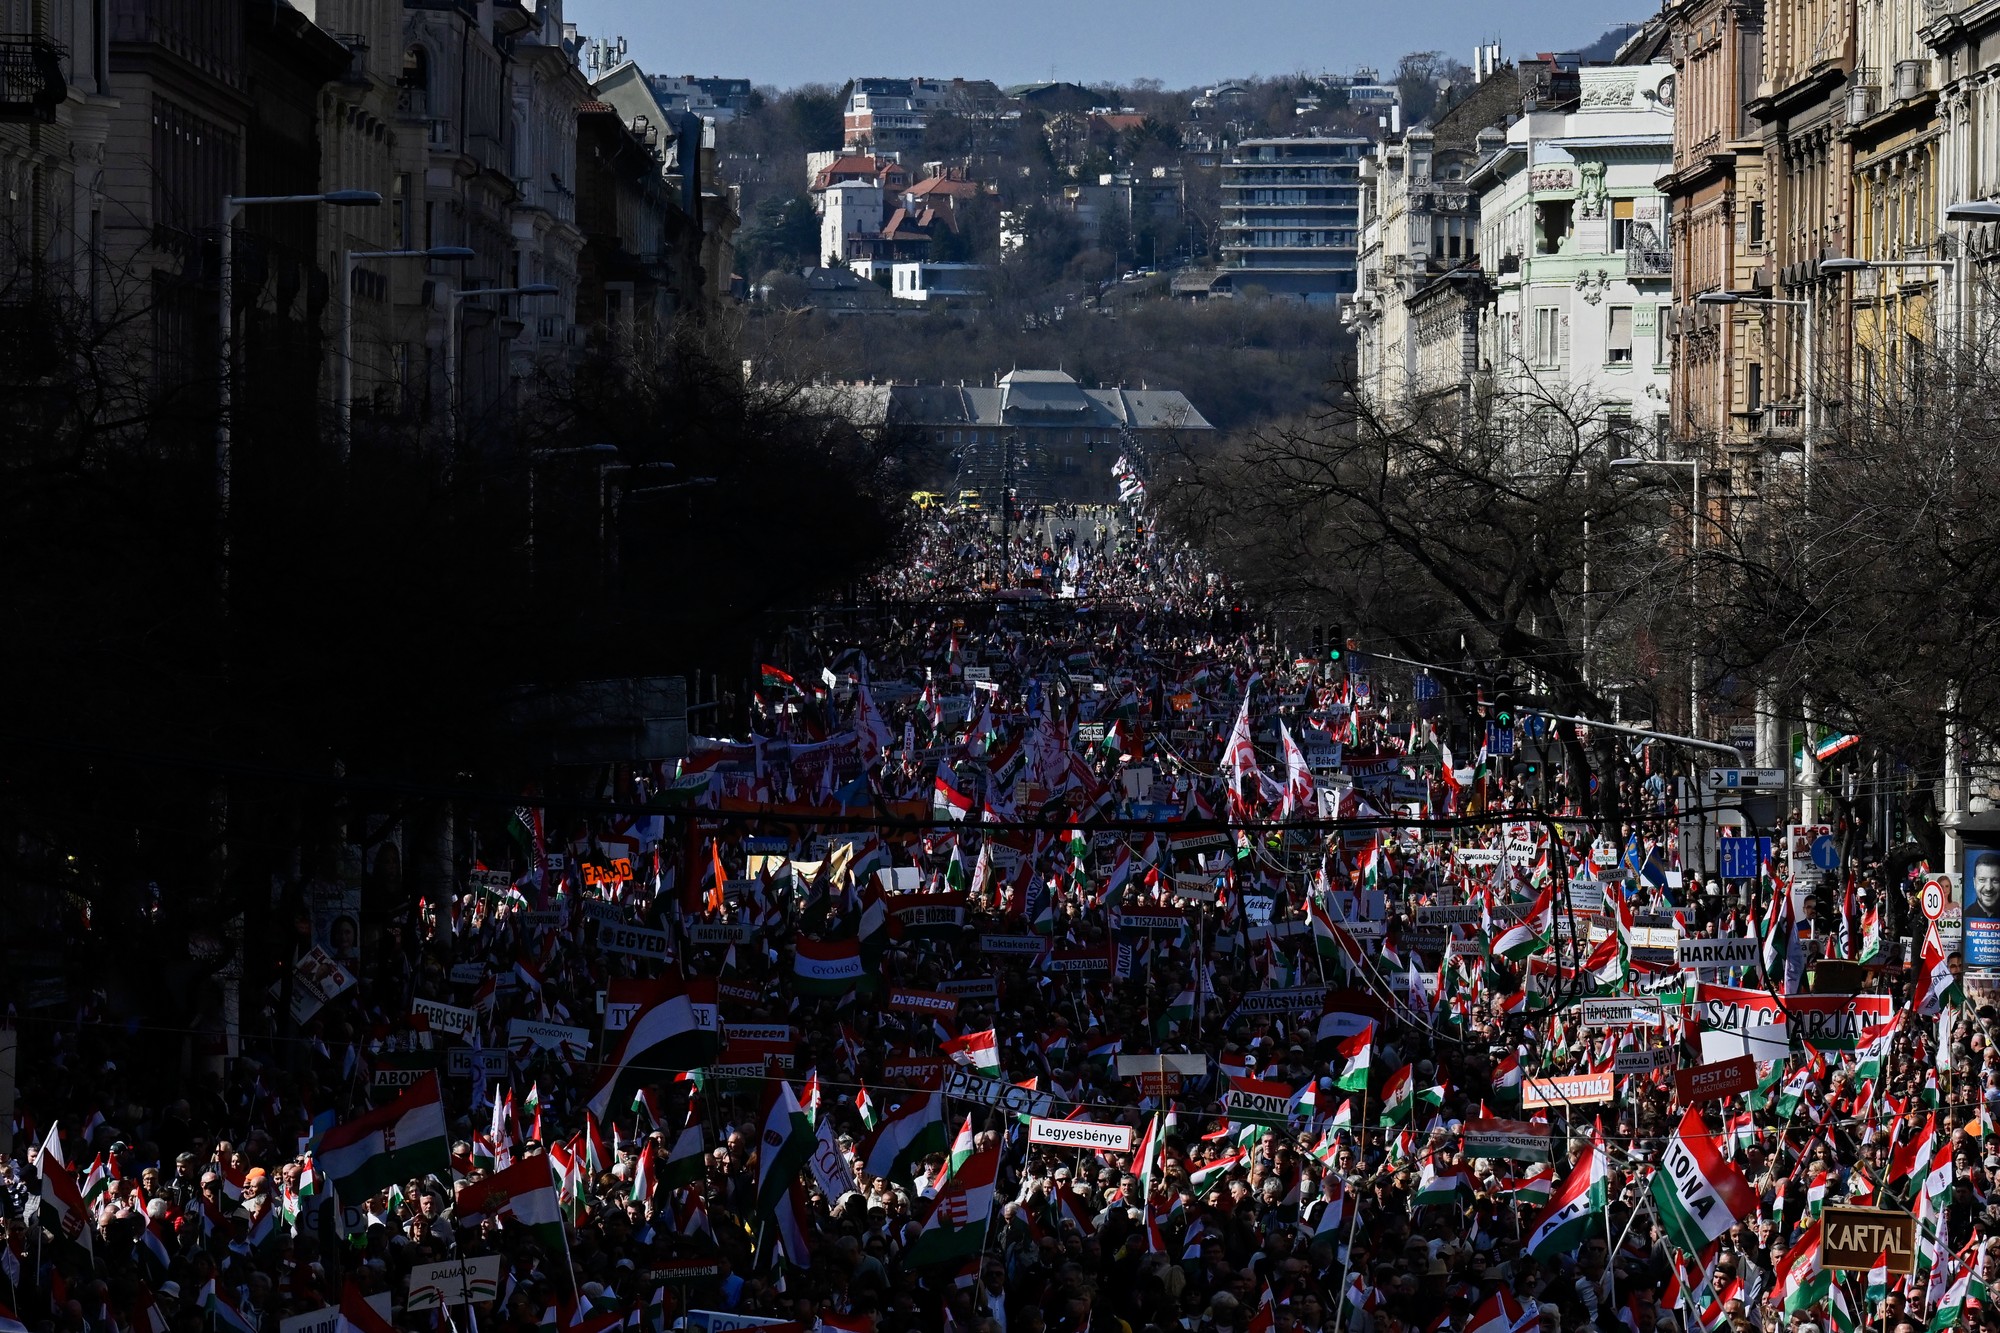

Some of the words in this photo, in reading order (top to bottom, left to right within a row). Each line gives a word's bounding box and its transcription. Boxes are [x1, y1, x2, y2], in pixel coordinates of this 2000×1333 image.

[1510, 843, 1533, 857] MAKÓ
[1572, 883, 1596, 891] Miskolc
[1927, 893, 1939, 909] 30
[1135, 917, 1179, 928] TISZADADA
[616, 931, 666, 952] EGYED
[987, 938, 1041, 950] Taktakenéz
[1680, 941, 1758, 962] HARKÁNY
[1064, 958, 1109, 970] TISZADADA
[946, 983, 993, 994] Debrecen
[1395, 977, 1434, 987] Váguta
[718, 984, 760, 1000] RECEN
[891, 994, 956, 1011] DEBRECEN
[1243, 991, 1327, 1011] KOVÁCSVÁGÁS
[1619, 1057, 1650, 1066] NYIRÁD
[378, 1071, 424, 1085] ABON
[1692, 1070, 1721, 1086] PEST
[1725, 1066, 1742, 1077] 06.
[1527, 1075, 1611, 1101] VERESEGYHÁZ
[1231, 1092, 1288, 1114] ABONY
[1038, 1120, 1122, 1145] Legyesbénye
[1466, 1135, 1548, 1148] HAJDÚBSZÖRMÉNY
[1670, 1145, 1715, 1221] TONA
[1826, 1222, 1911, 1255] KARTAL
[431, 1265, 477, 1280] DALMAND
